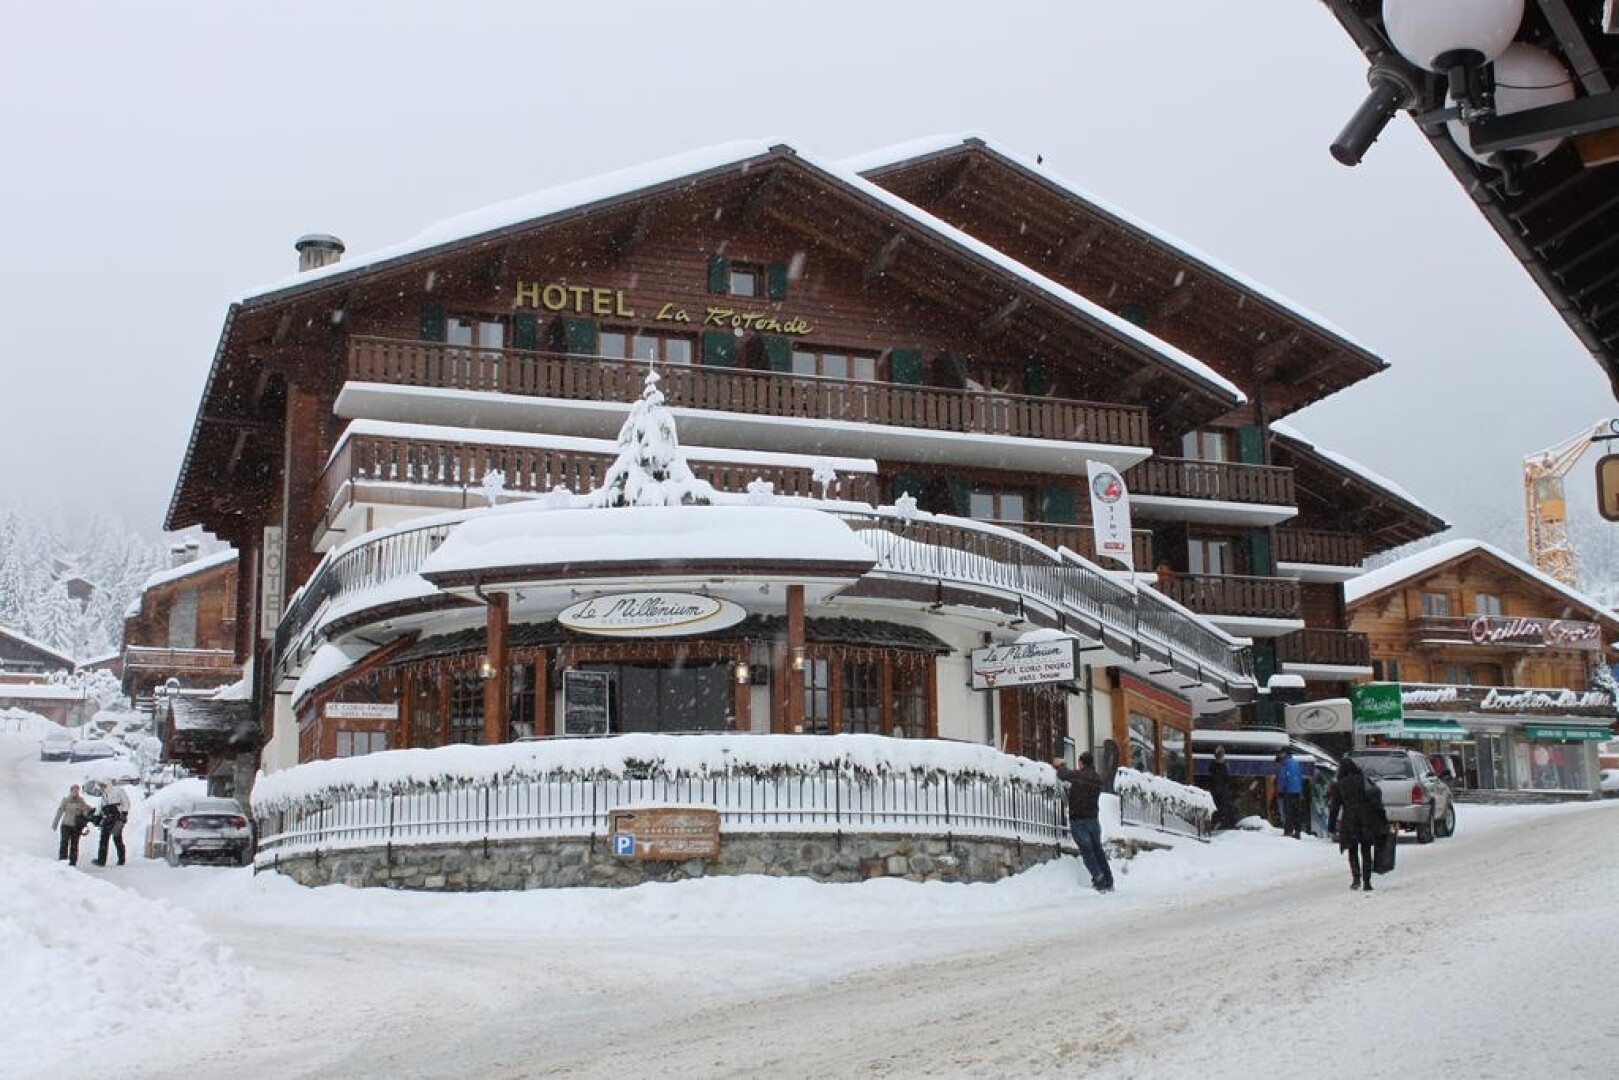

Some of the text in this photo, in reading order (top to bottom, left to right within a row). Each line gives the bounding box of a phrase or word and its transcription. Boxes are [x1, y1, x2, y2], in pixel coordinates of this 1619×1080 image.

[516, 281, 635, 317] HOTEL
[656, 303, 813, 334] La Rotonde
[265, 532, 280, 632] HOTEL
[572, 600, 596, 618] Le
[618, 837, 630, 854] P
